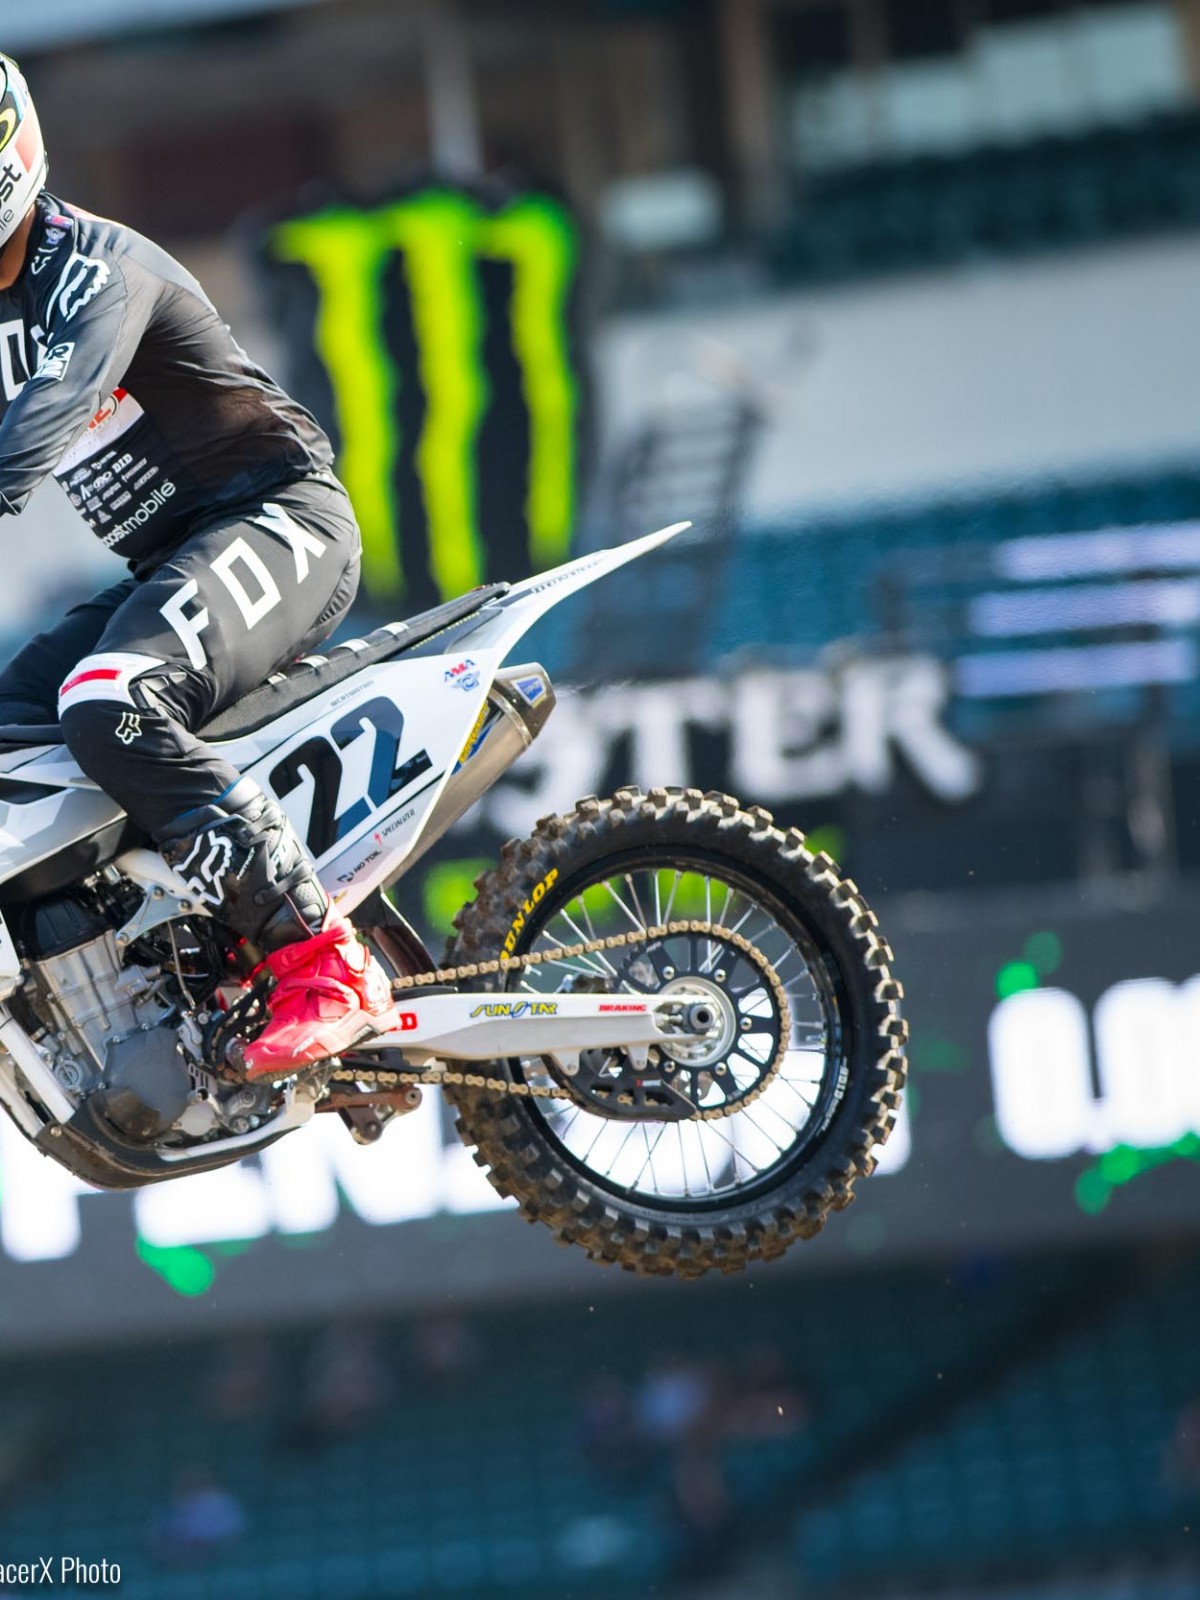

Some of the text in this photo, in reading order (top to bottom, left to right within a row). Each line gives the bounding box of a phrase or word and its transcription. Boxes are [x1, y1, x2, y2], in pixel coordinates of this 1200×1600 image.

[111, 453, 134, 474] DID
[159, 502, 327, 671] FOX
[444, 659, 475, 682] AMA
[268, 696, 434, 860] 22
[381, 808, 416, 837] SPECIALIZED
[500, 867, 559, 961] DUNLOP
[598, 1003, 647, 1013] BRAKING
